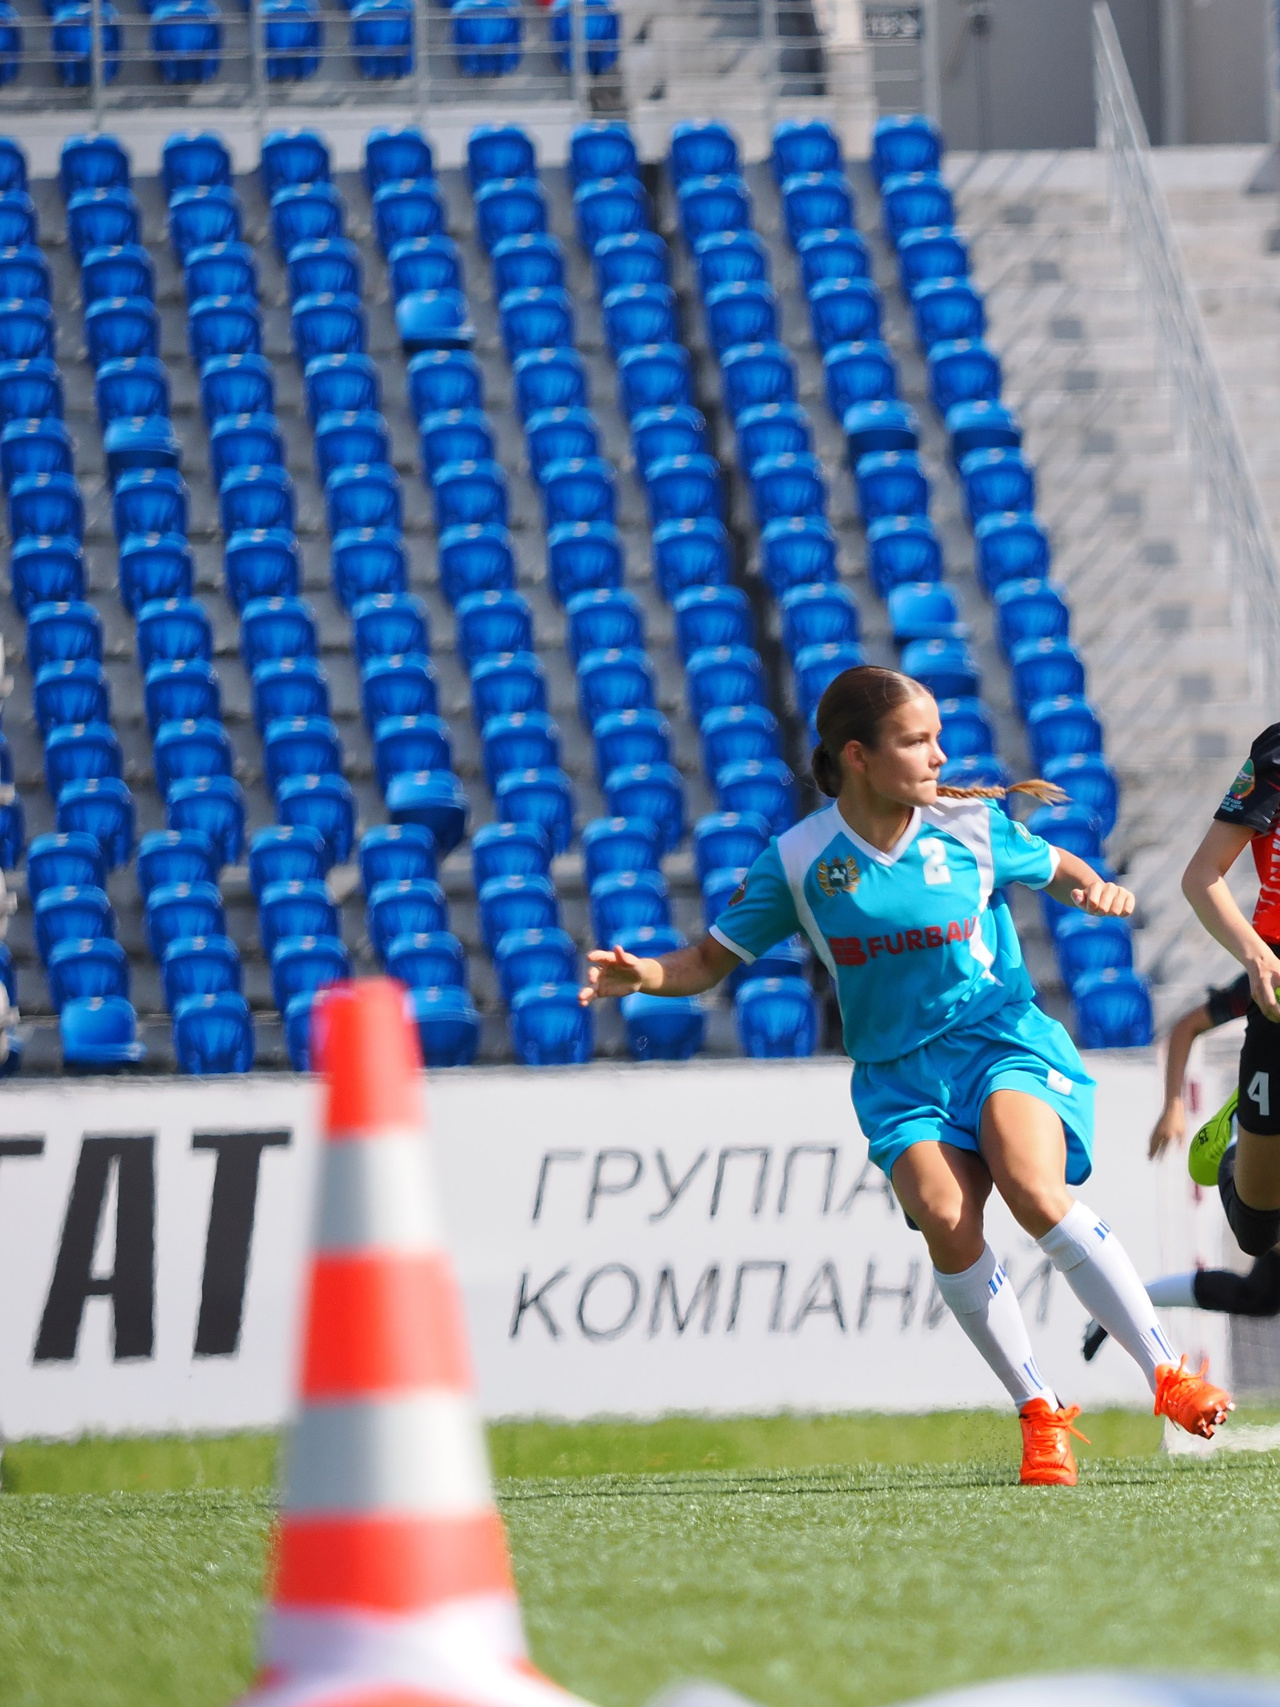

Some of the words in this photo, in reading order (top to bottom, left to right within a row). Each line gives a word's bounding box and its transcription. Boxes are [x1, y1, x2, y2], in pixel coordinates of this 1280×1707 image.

[917, 837, 952, 885] 2
[1247, 1070, 1270, 1116] 4
[0, 1127, 292, 1367] АТ
